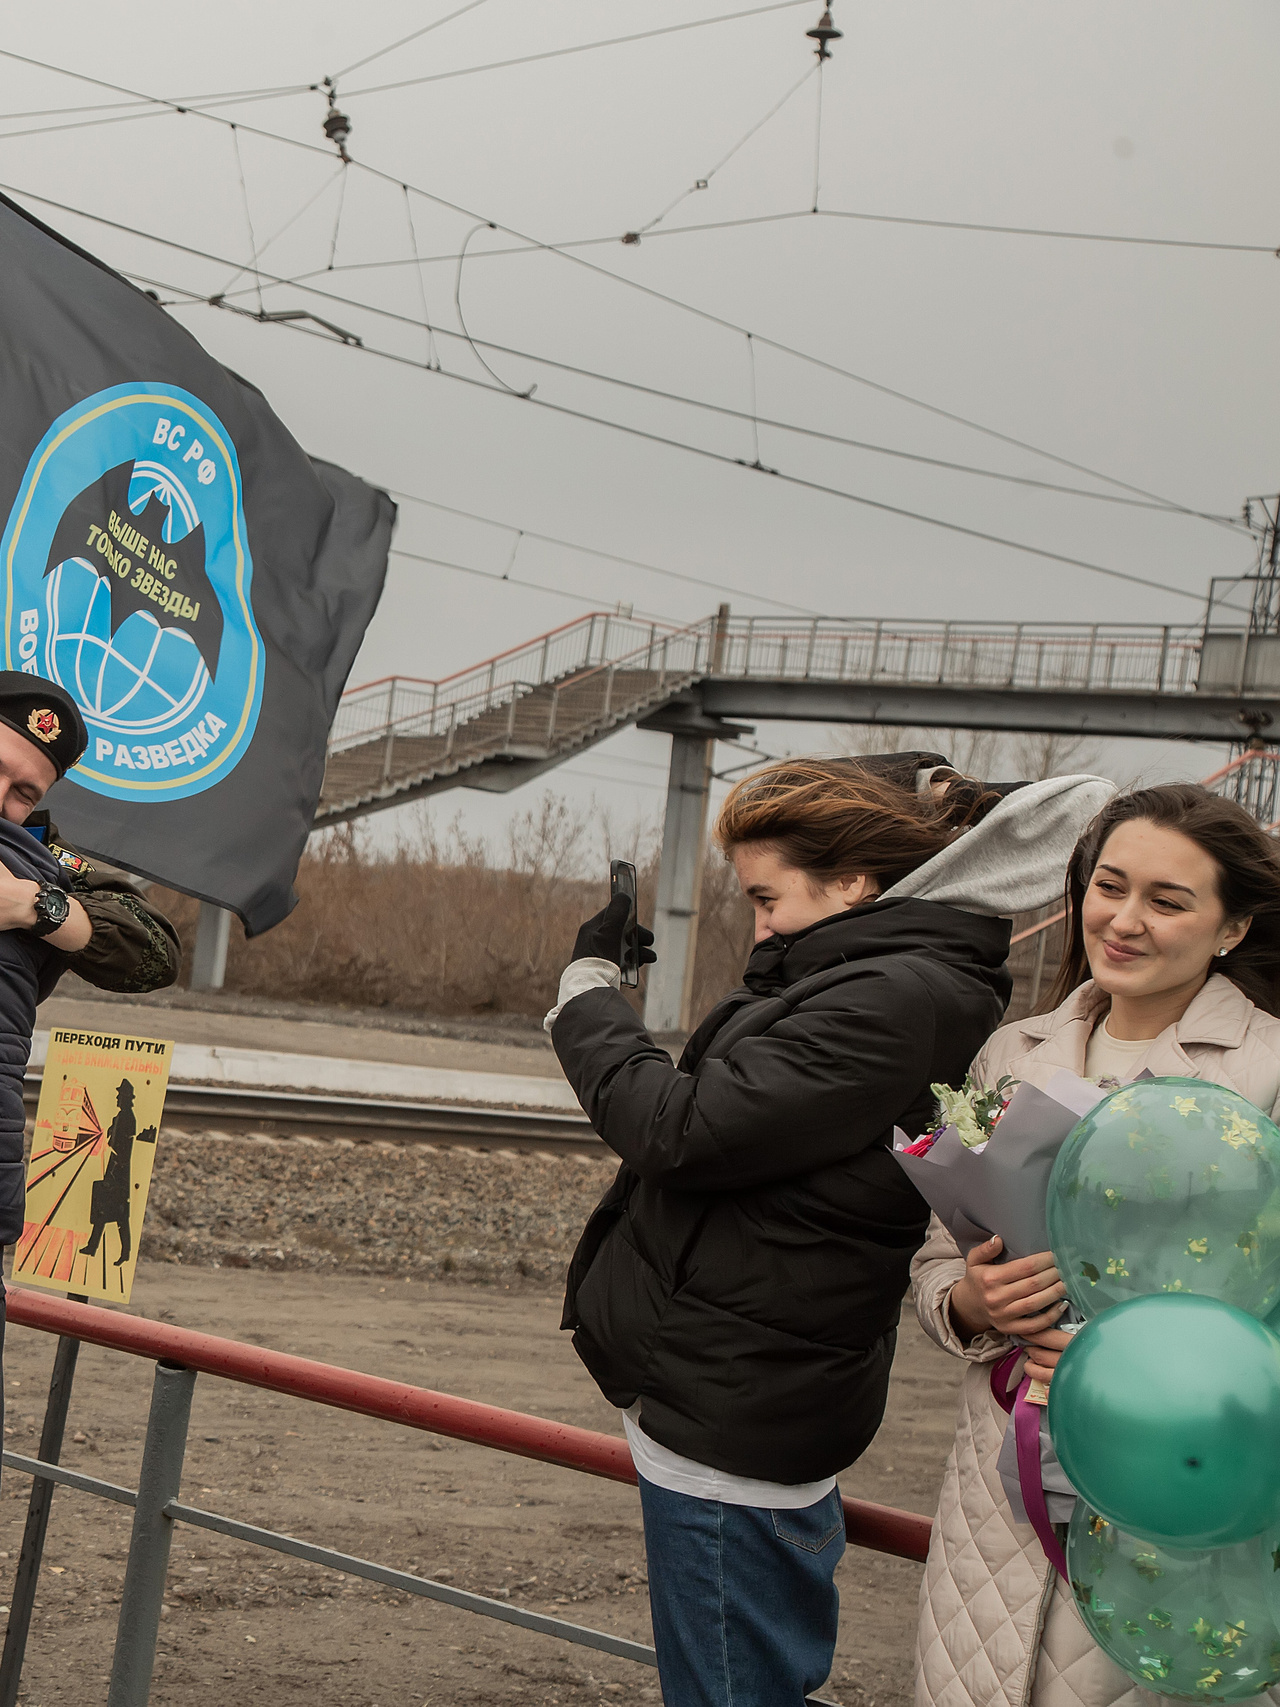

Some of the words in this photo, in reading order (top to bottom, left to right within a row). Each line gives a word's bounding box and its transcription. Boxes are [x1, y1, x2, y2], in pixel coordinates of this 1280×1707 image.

[152, 417, 186, 451] ВС
[182, 438, 216, 485] РФ
[107, 509, 150, 559] ВЫШЕ
[147, 544, 178, 580] НАС
[130, 567, 201, 622] ЗВЕЗДЫ
[95, 711, 228, 770] РАЗВЕДКА
[54, 1031, 121, 1050] ПЕРЕХОДЯ
[124, 1039, 166, 1055] ПУТИ
[54, 1049, 83, 1066] УДЬТЕ
